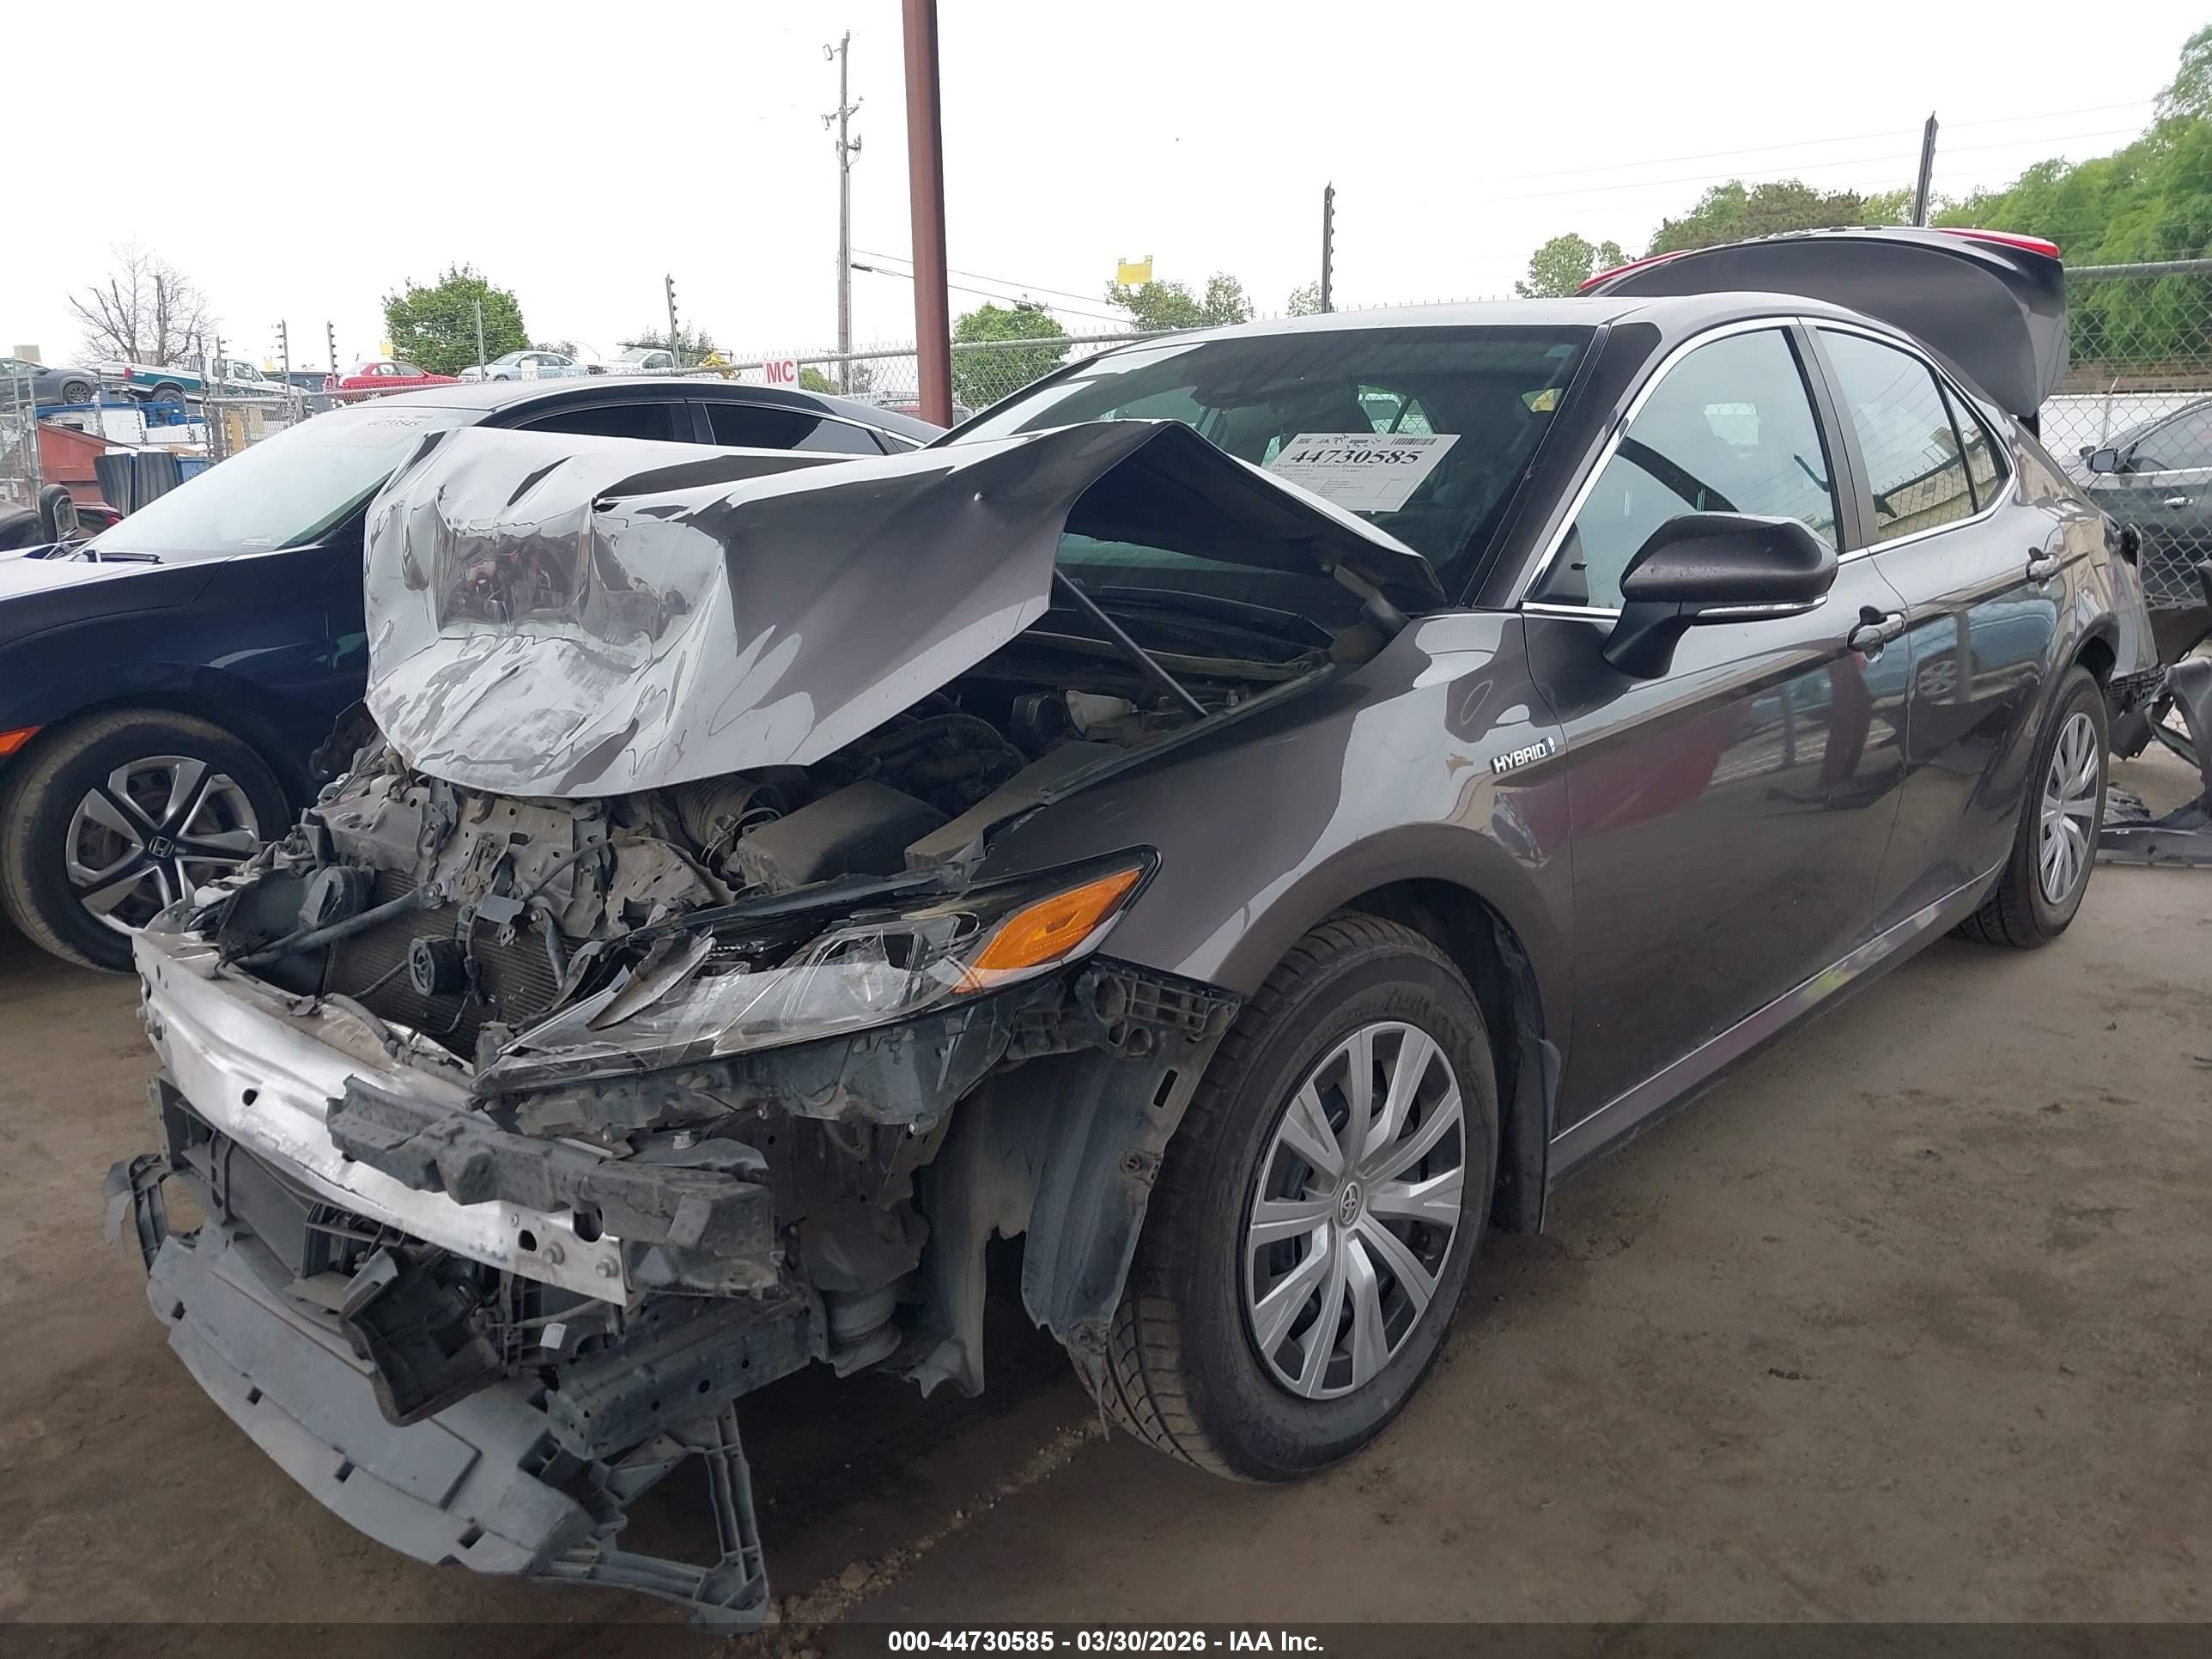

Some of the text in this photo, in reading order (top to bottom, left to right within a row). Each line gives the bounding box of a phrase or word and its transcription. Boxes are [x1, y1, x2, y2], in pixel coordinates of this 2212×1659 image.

[766, 361, 794, 383] MC
[1291, 448, 1425, 465] 44730585
[1493, 743, 1547, 775] HYBRID
